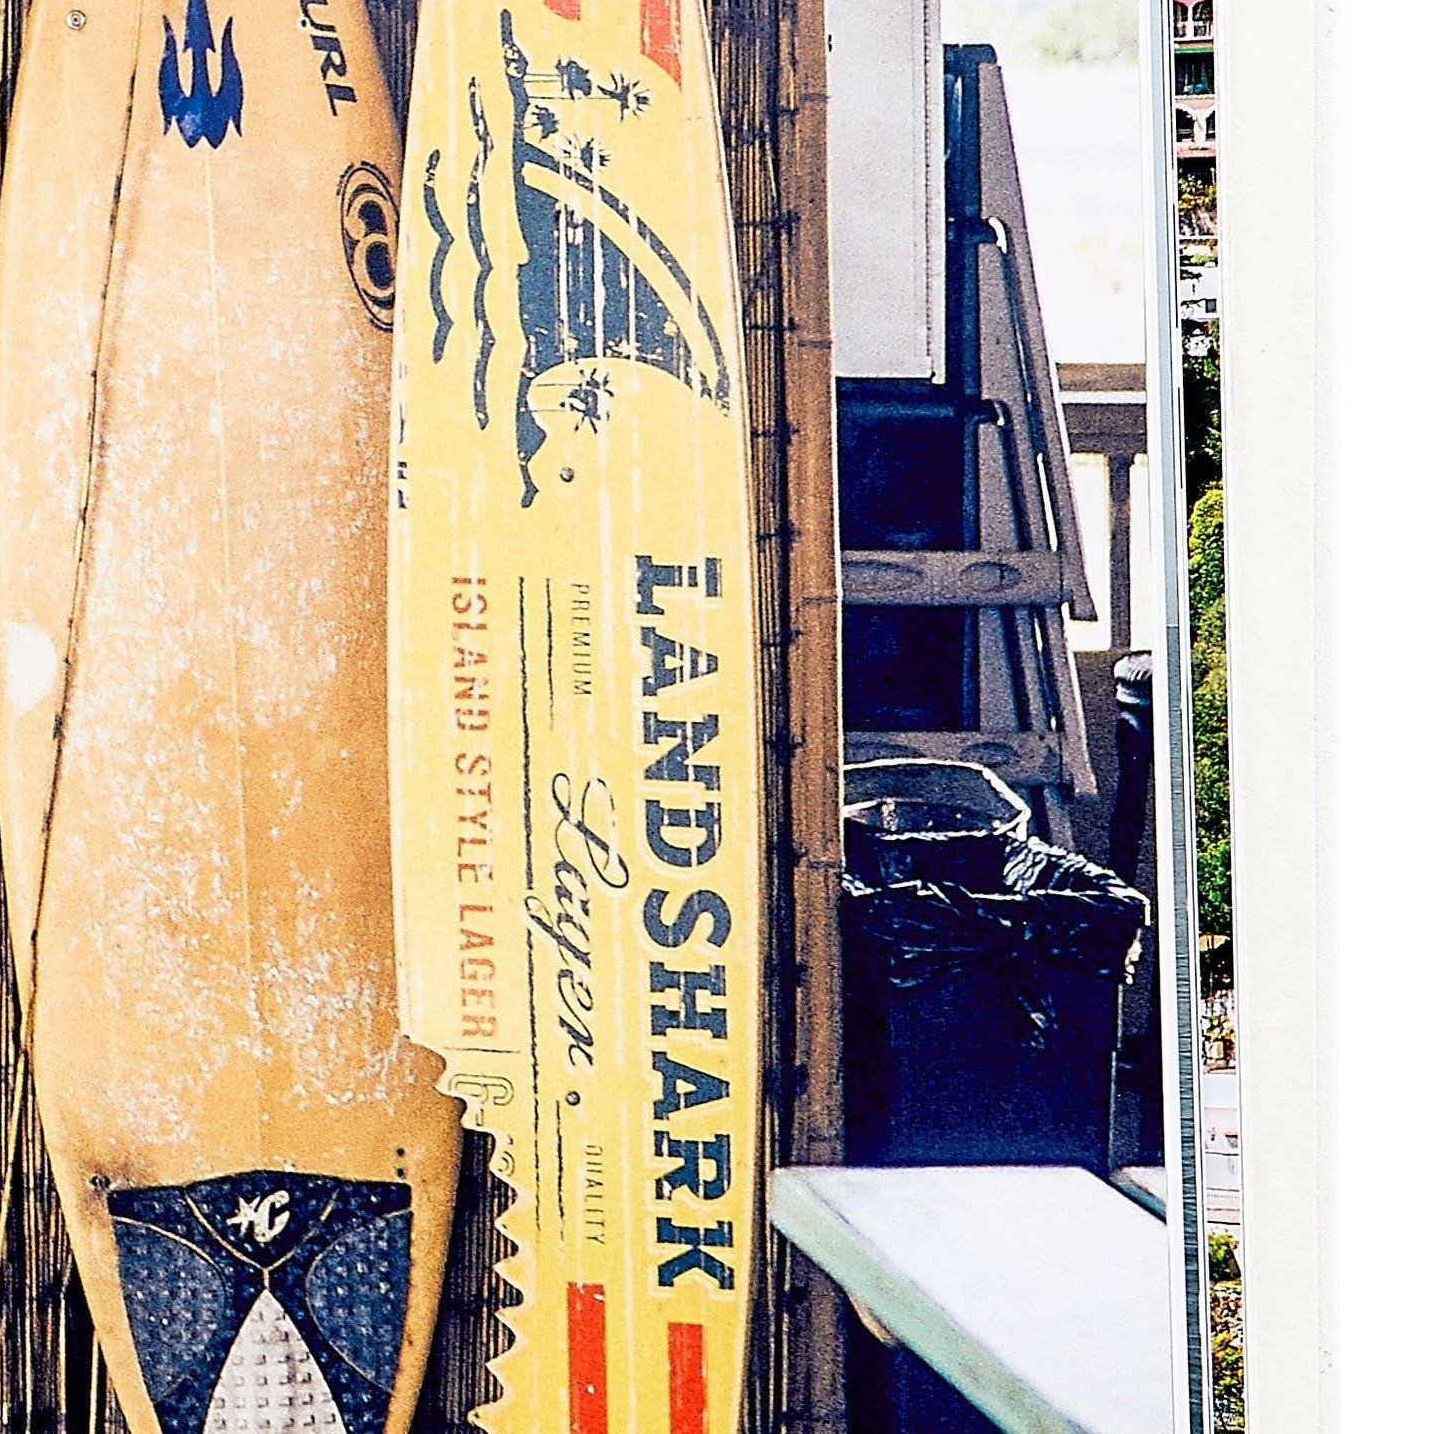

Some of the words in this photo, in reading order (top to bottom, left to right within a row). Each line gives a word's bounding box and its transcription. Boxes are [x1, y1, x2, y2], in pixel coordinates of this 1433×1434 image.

[450, 576, 488, 733] ISLAND
[571, 584, 593, 697] PREMIUM
[453, 754, 494, 885] STYLE
[457, 903, 497, 1039] LAGER
[524, 774, 631, 1067] Lager
[635, 554, 736, 1291] LANDSHARK
[584, 1144, 606, 1246] QUALITY
